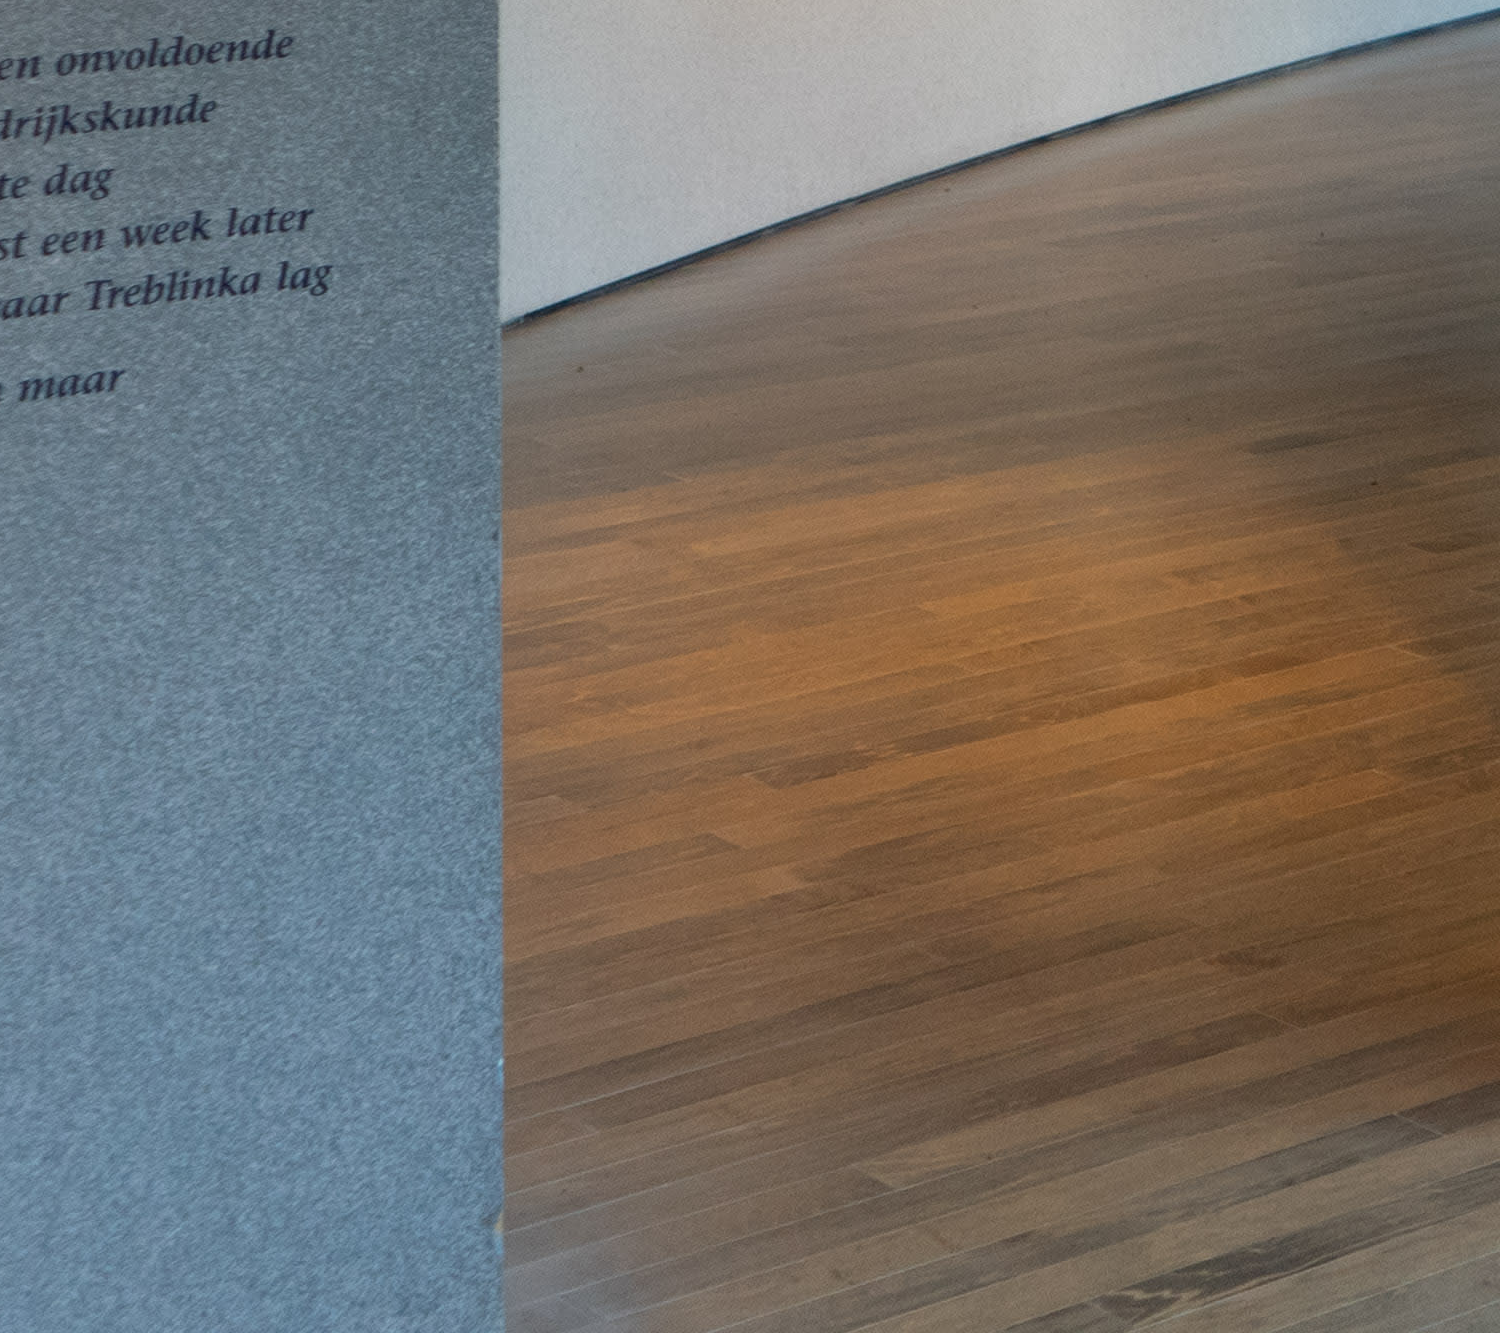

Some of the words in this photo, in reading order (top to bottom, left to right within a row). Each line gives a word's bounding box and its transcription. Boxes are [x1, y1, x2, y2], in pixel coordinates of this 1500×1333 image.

[55, 29, 295, 78] onvoldoende
[43, 163, 115, 201] dag
[41, 225, 106, 257] een
[121, 209, 213, 249] week
[226, 207, 315, 239] later
[84, 266, 262, 312] Treblinka
[276, 259, 334, 297] lag
[18, 366, 127, 404] maar
